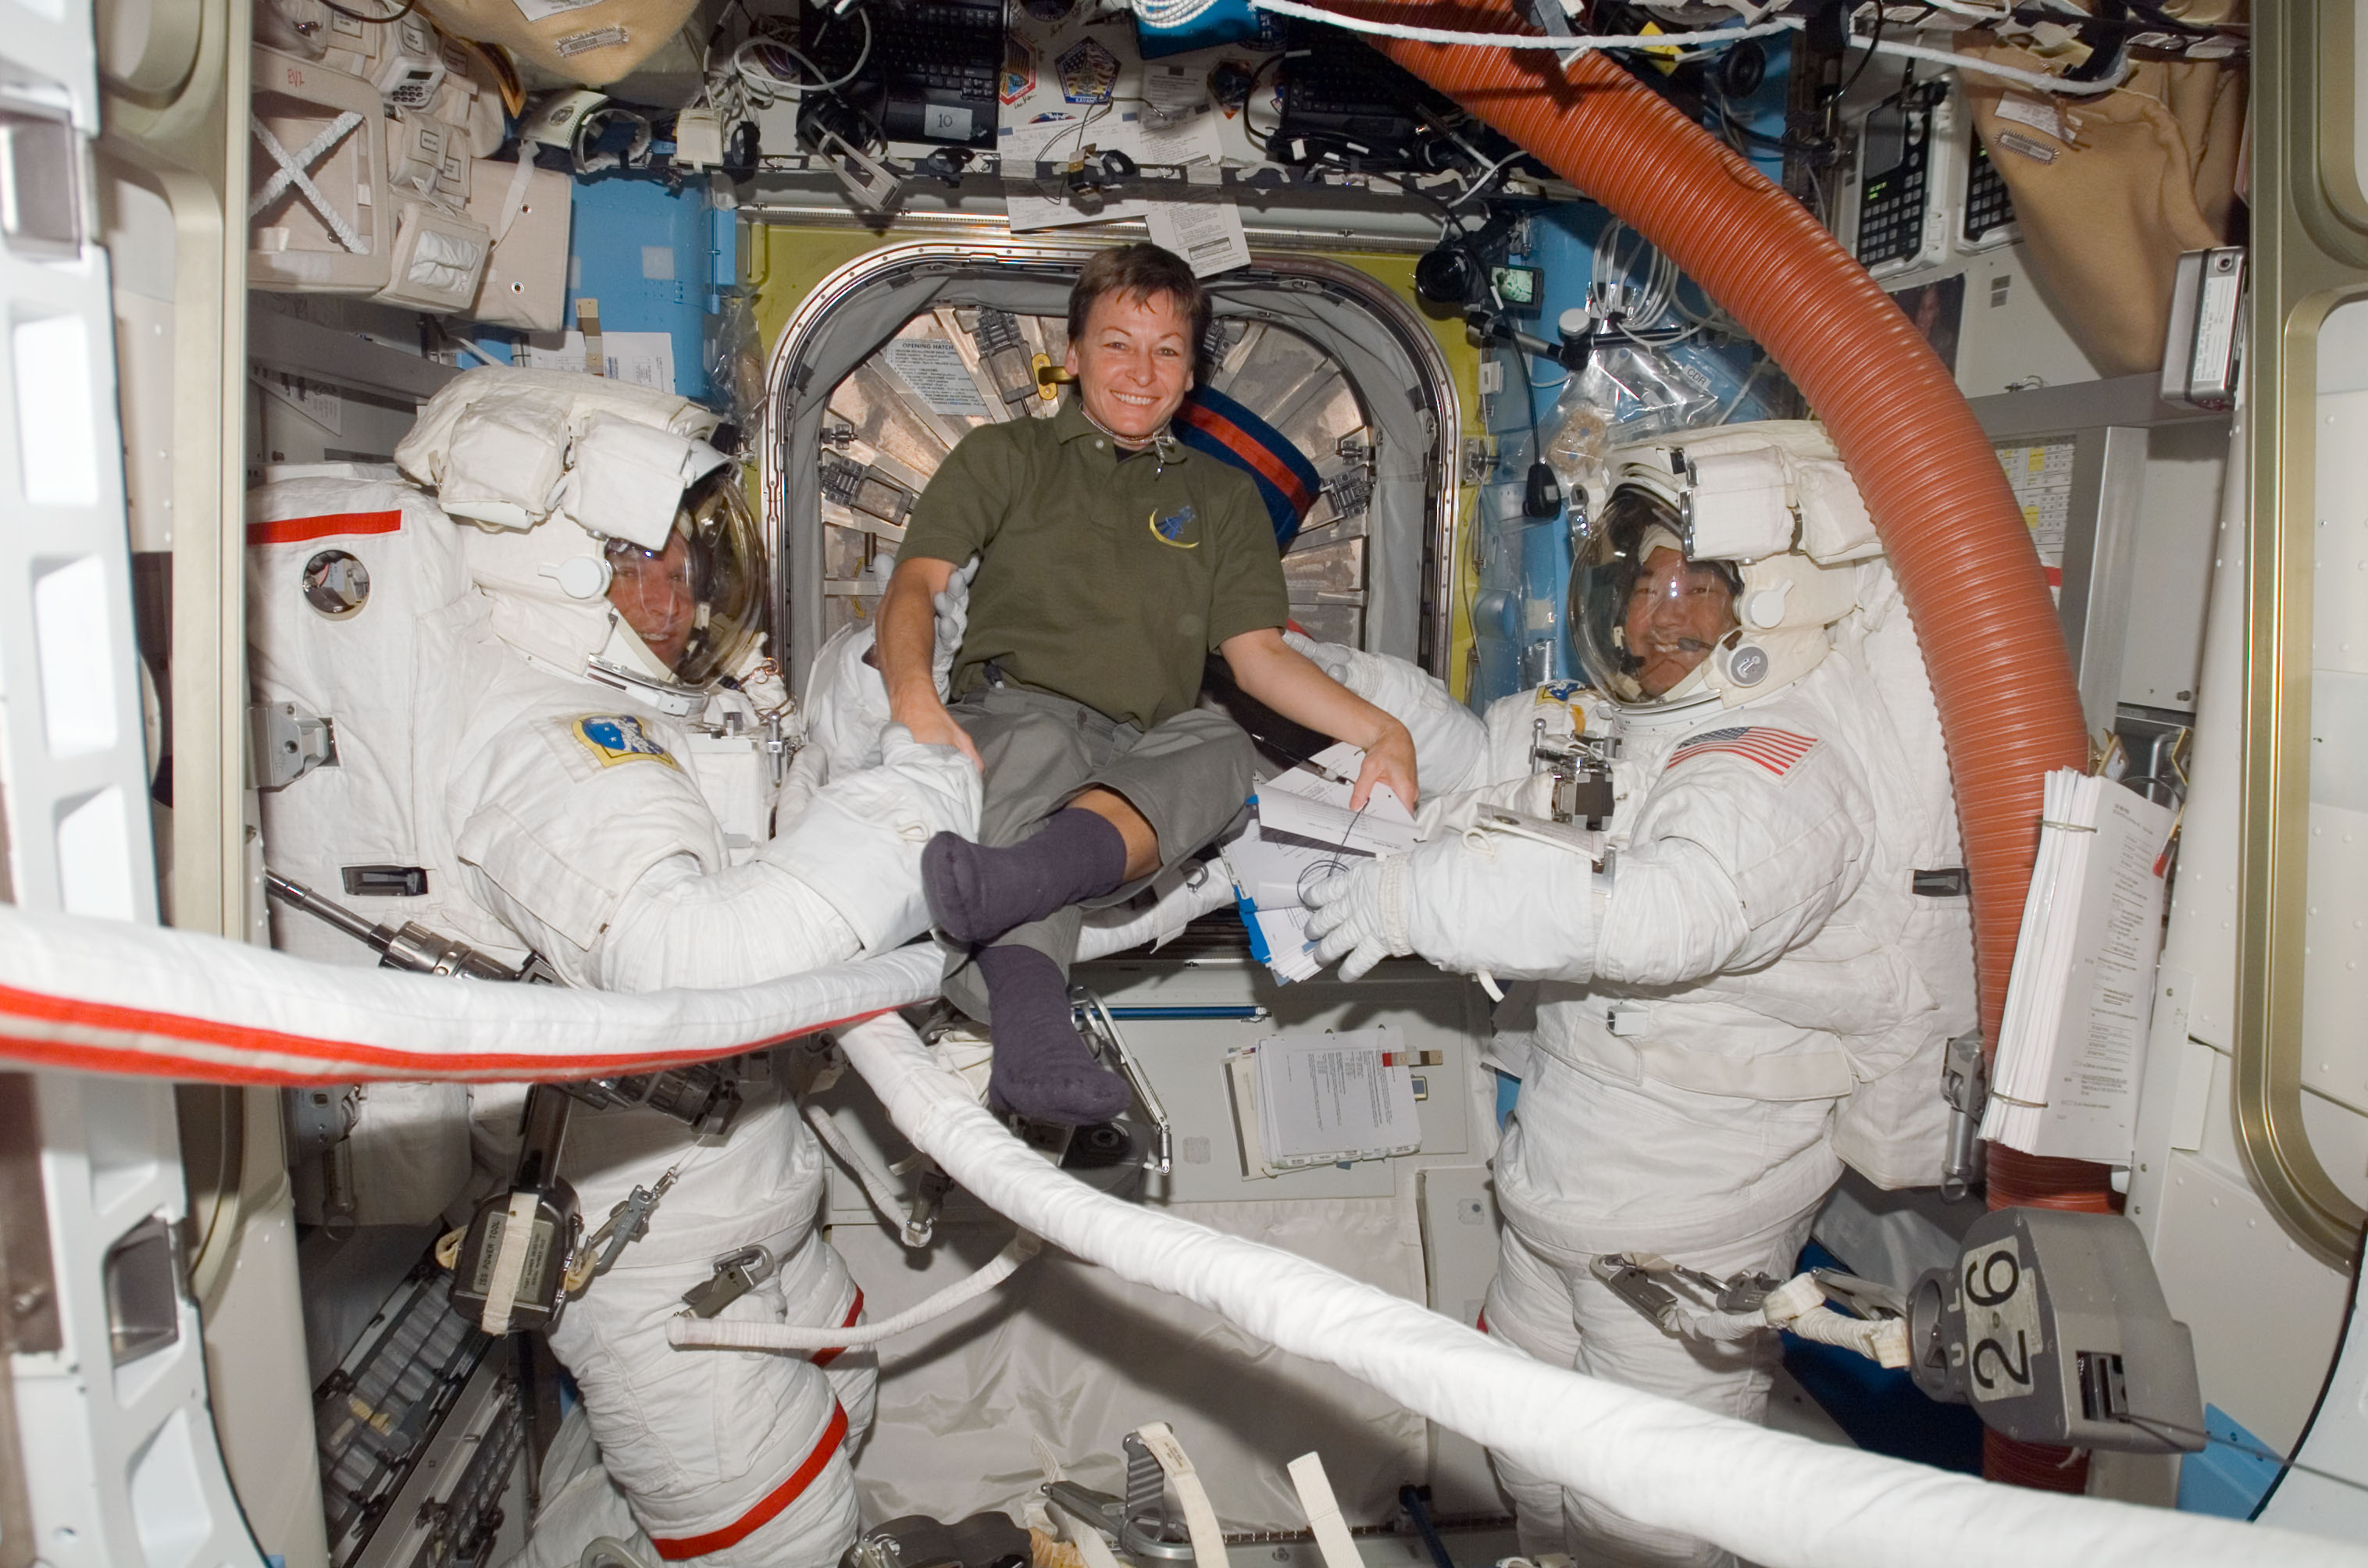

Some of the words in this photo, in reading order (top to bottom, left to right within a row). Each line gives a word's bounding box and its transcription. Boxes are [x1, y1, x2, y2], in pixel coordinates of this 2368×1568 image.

[938, 113, 953, 128] 10
[1687, 369, 1706, 385] CDR
[489, 1221, 500, 1238] TOOL
[483, 1244, 494, 1270] POWER
[479, 1273, 488, 1286] ISS
